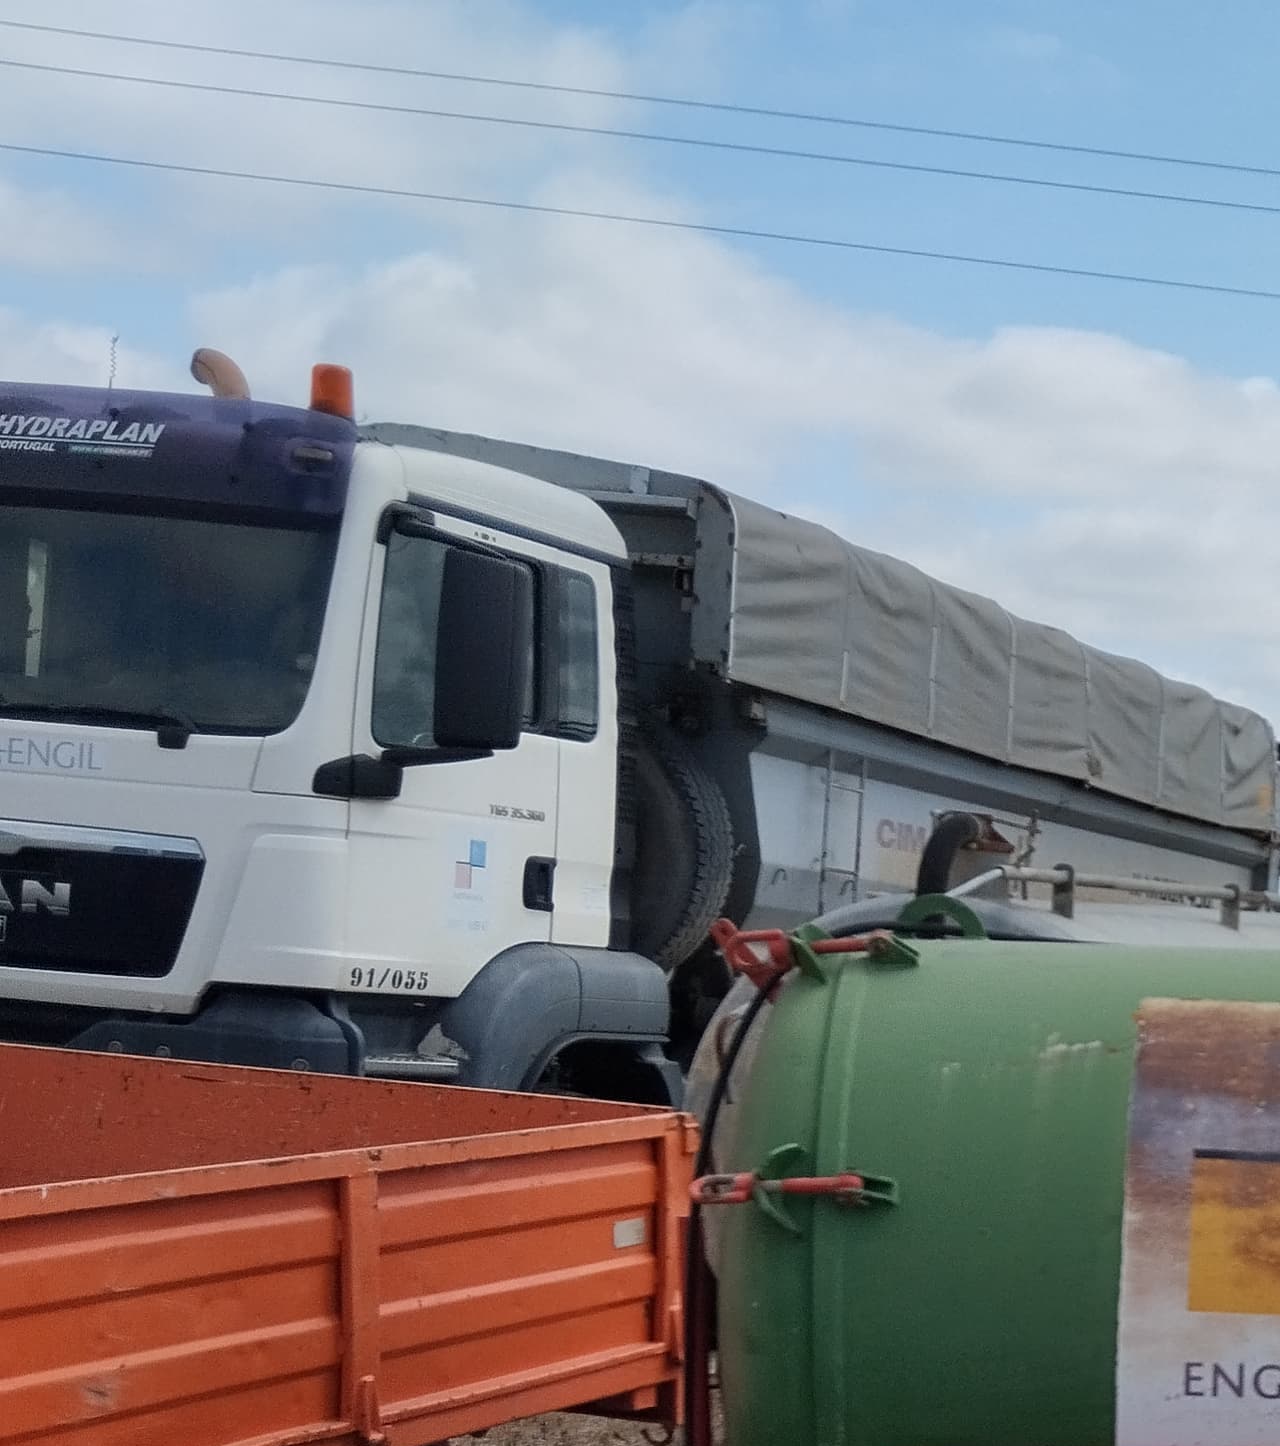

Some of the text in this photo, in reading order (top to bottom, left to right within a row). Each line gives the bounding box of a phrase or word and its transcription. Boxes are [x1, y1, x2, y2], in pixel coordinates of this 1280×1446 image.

[0, 414, 165, 443] HYDRAPLAN
[0, 440, 55, 451] ORTUGAL
[350, 966, 428, 991] 91/055
